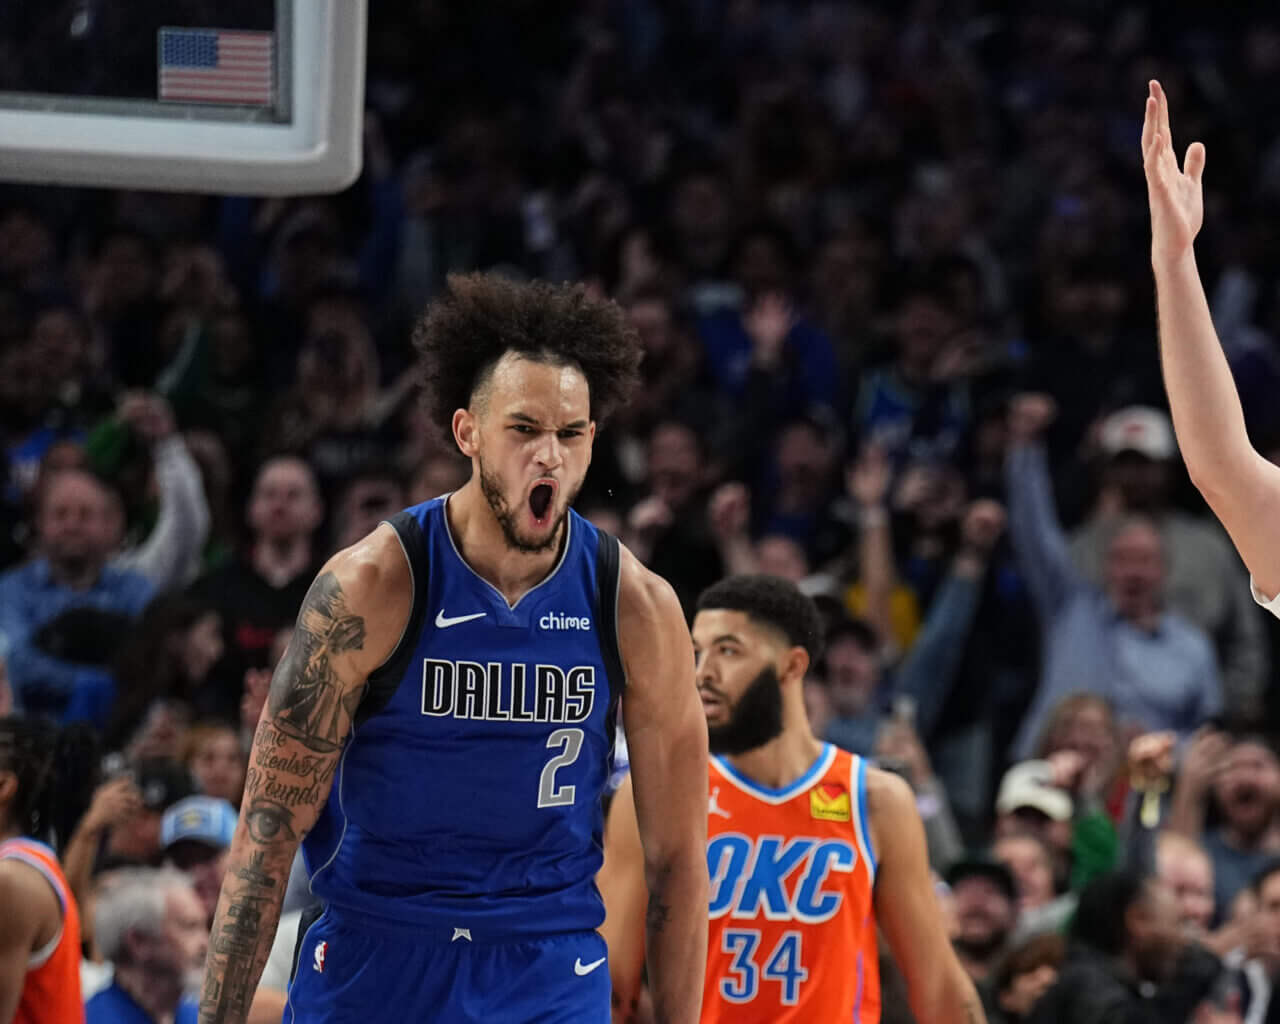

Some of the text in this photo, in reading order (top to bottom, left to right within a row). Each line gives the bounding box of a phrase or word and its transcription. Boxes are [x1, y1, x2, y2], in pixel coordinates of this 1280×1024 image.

[539, 612, 591, 631] chime
[421, 657, 595, 723] DALLAS
[537, 727, 585, 809] 2
[706, 831, 858, 925] OKC
[719, 927, 809, 1006] 34
